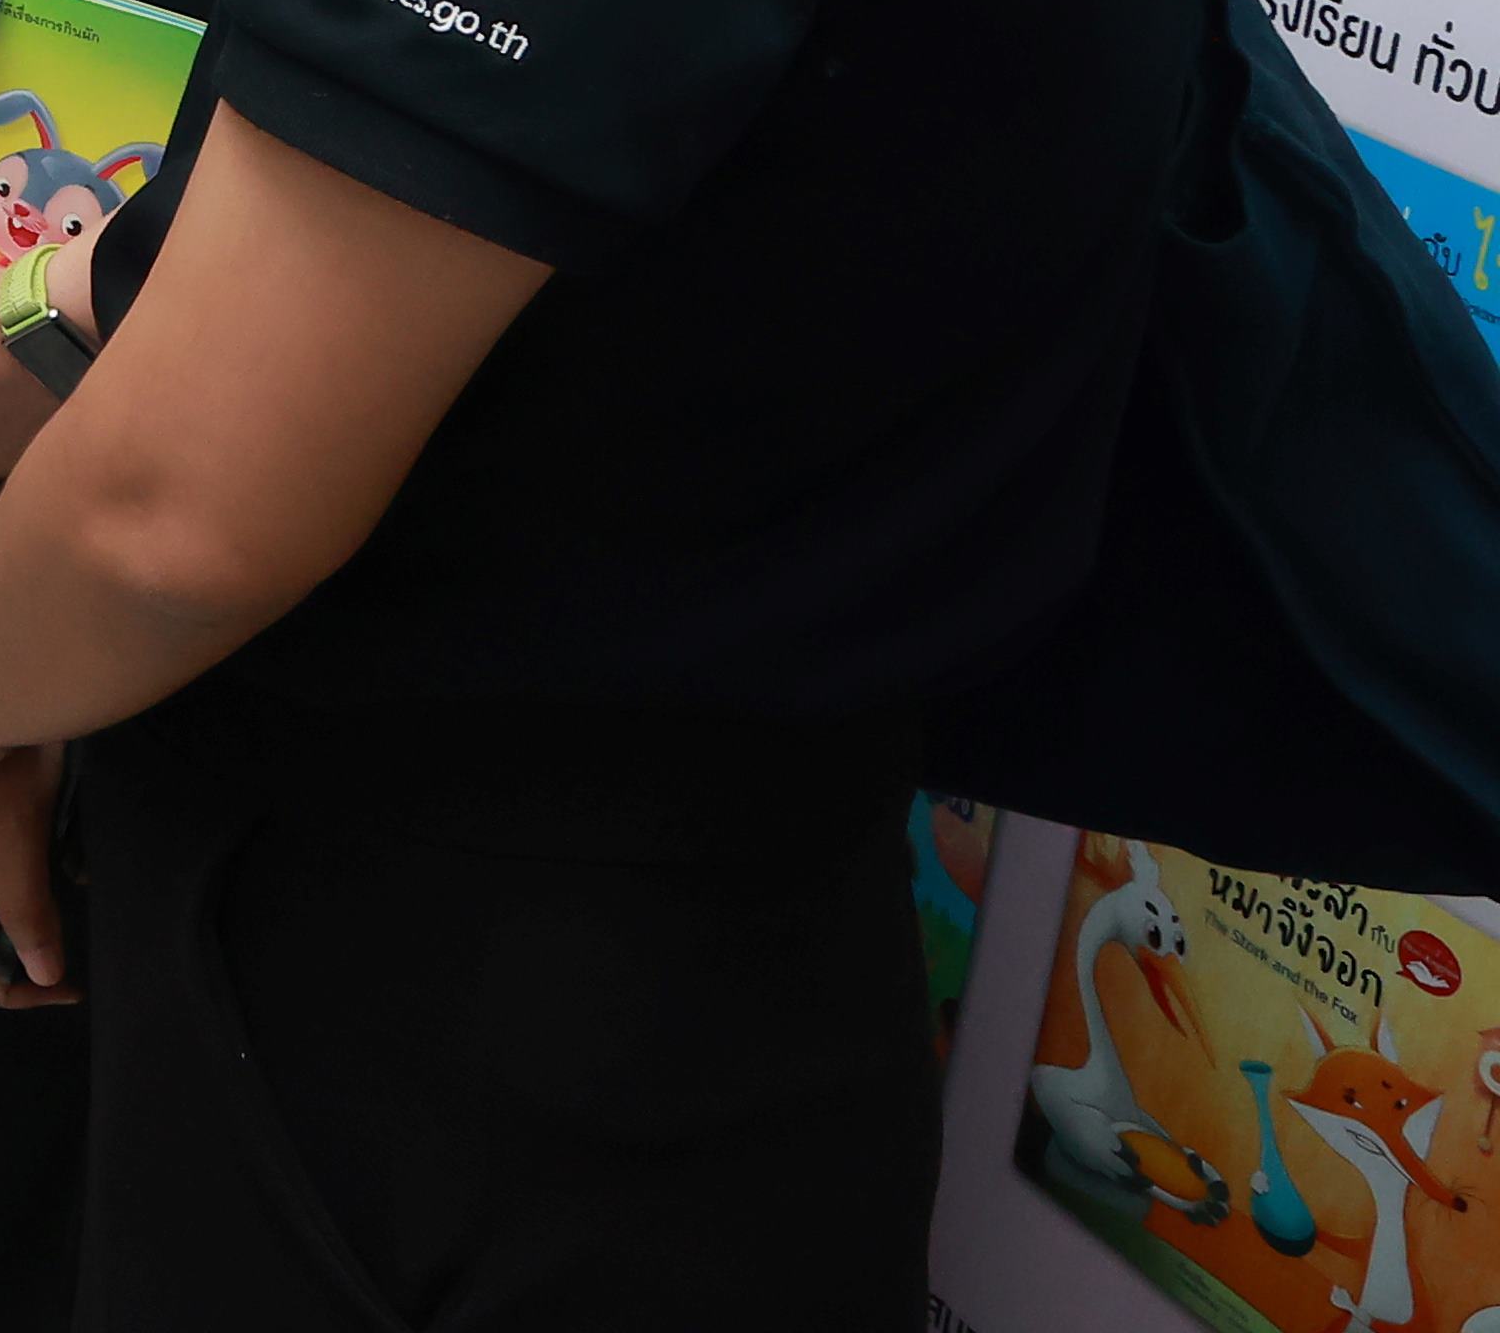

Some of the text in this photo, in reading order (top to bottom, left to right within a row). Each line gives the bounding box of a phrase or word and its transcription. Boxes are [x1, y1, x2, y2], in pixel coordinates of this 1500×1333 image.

[1204, 908, 1360, 1025] The Stork and the Fox
[1208, 867, 1383, 1009] หมาจิ้งจอก
